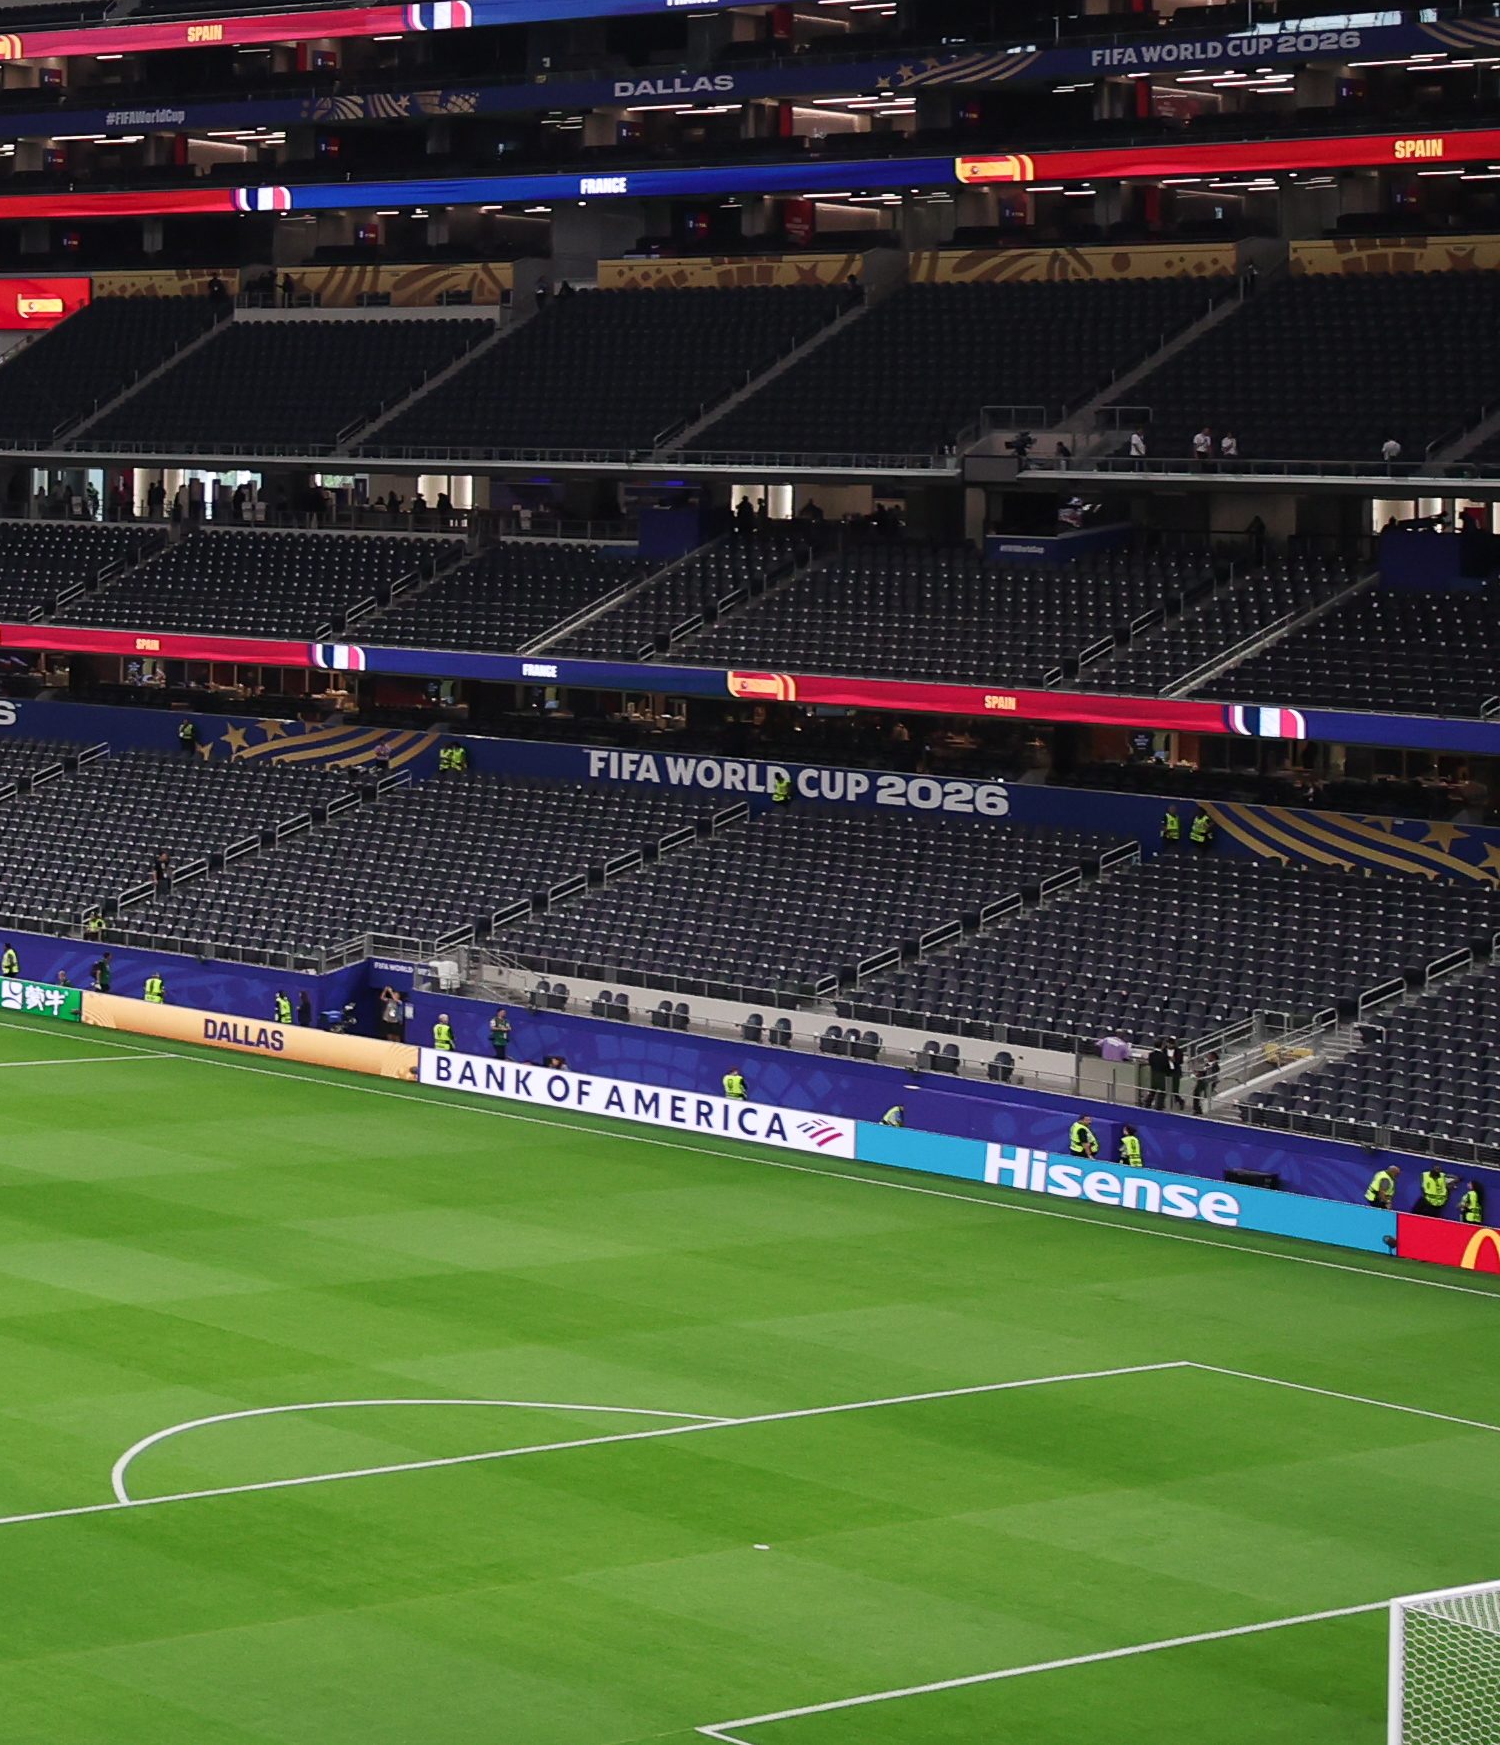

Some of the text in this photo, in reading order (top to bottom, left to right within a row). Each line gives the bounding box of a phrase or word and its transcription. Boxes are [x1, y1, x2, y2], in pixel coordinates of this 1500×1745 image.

[188, 25, 222, 42] SPAIN
[1091, 31, 1362, 67] FIFA WORLD CUP 2026
[613, 75, 736, 97] DALLAS
[106, 109, 184, 125] #FIFAWorldCup
[1395, 139, 1442, 158] SPAIN
[581, 177, 626, 194] FRANCE
[136, 639, 159, 650] SPAIN
[523, 664, 557, 677] FRANCE
[985, 695, 1015, 710] SPAIN
[589, 749, 1011, 817] FIFA WORLD CUP 2026
[203, 1018, 284, 1052] DALLAS
[436, 1054, 790, 1143] BANK OF AMERICA
[984, 1142, 1240, 1227] Hisense
